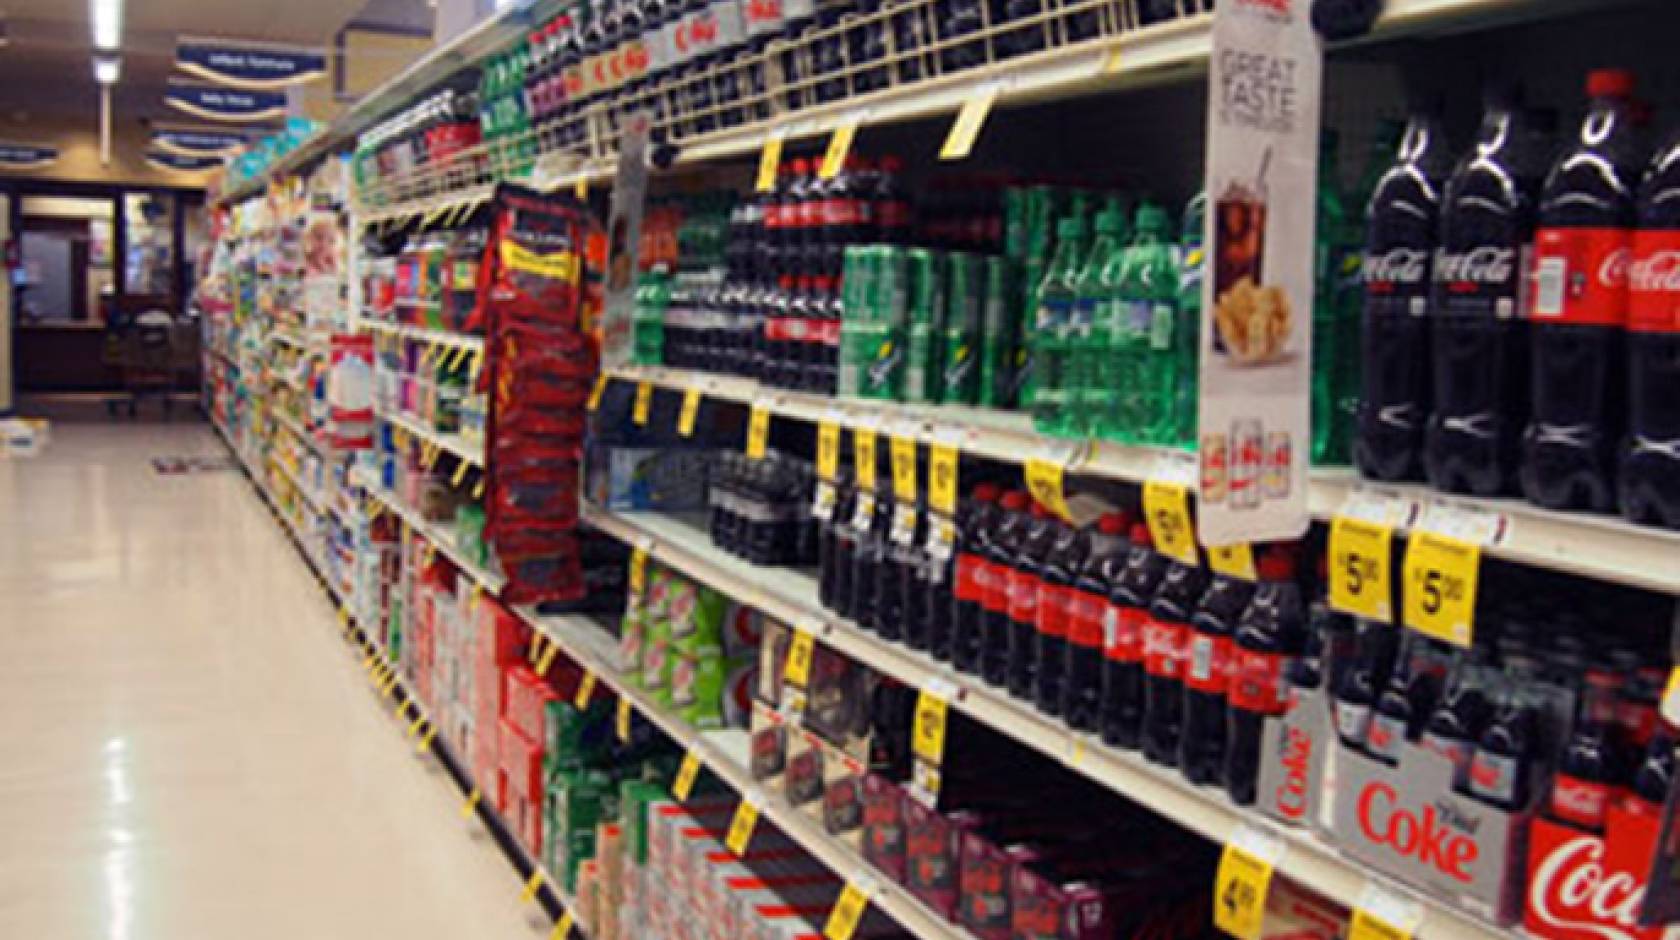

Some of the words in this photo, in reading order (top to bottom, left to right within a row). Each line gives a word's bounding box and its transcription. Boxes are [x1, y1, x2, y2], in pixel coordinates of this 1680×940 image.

[1221, 49, 1297, 83] GREAT
[1221, 76, 1297, 114] TASTE
[1276, 726, 1312, 819] Coke
[1356, 778, 1480, 885] Coke
